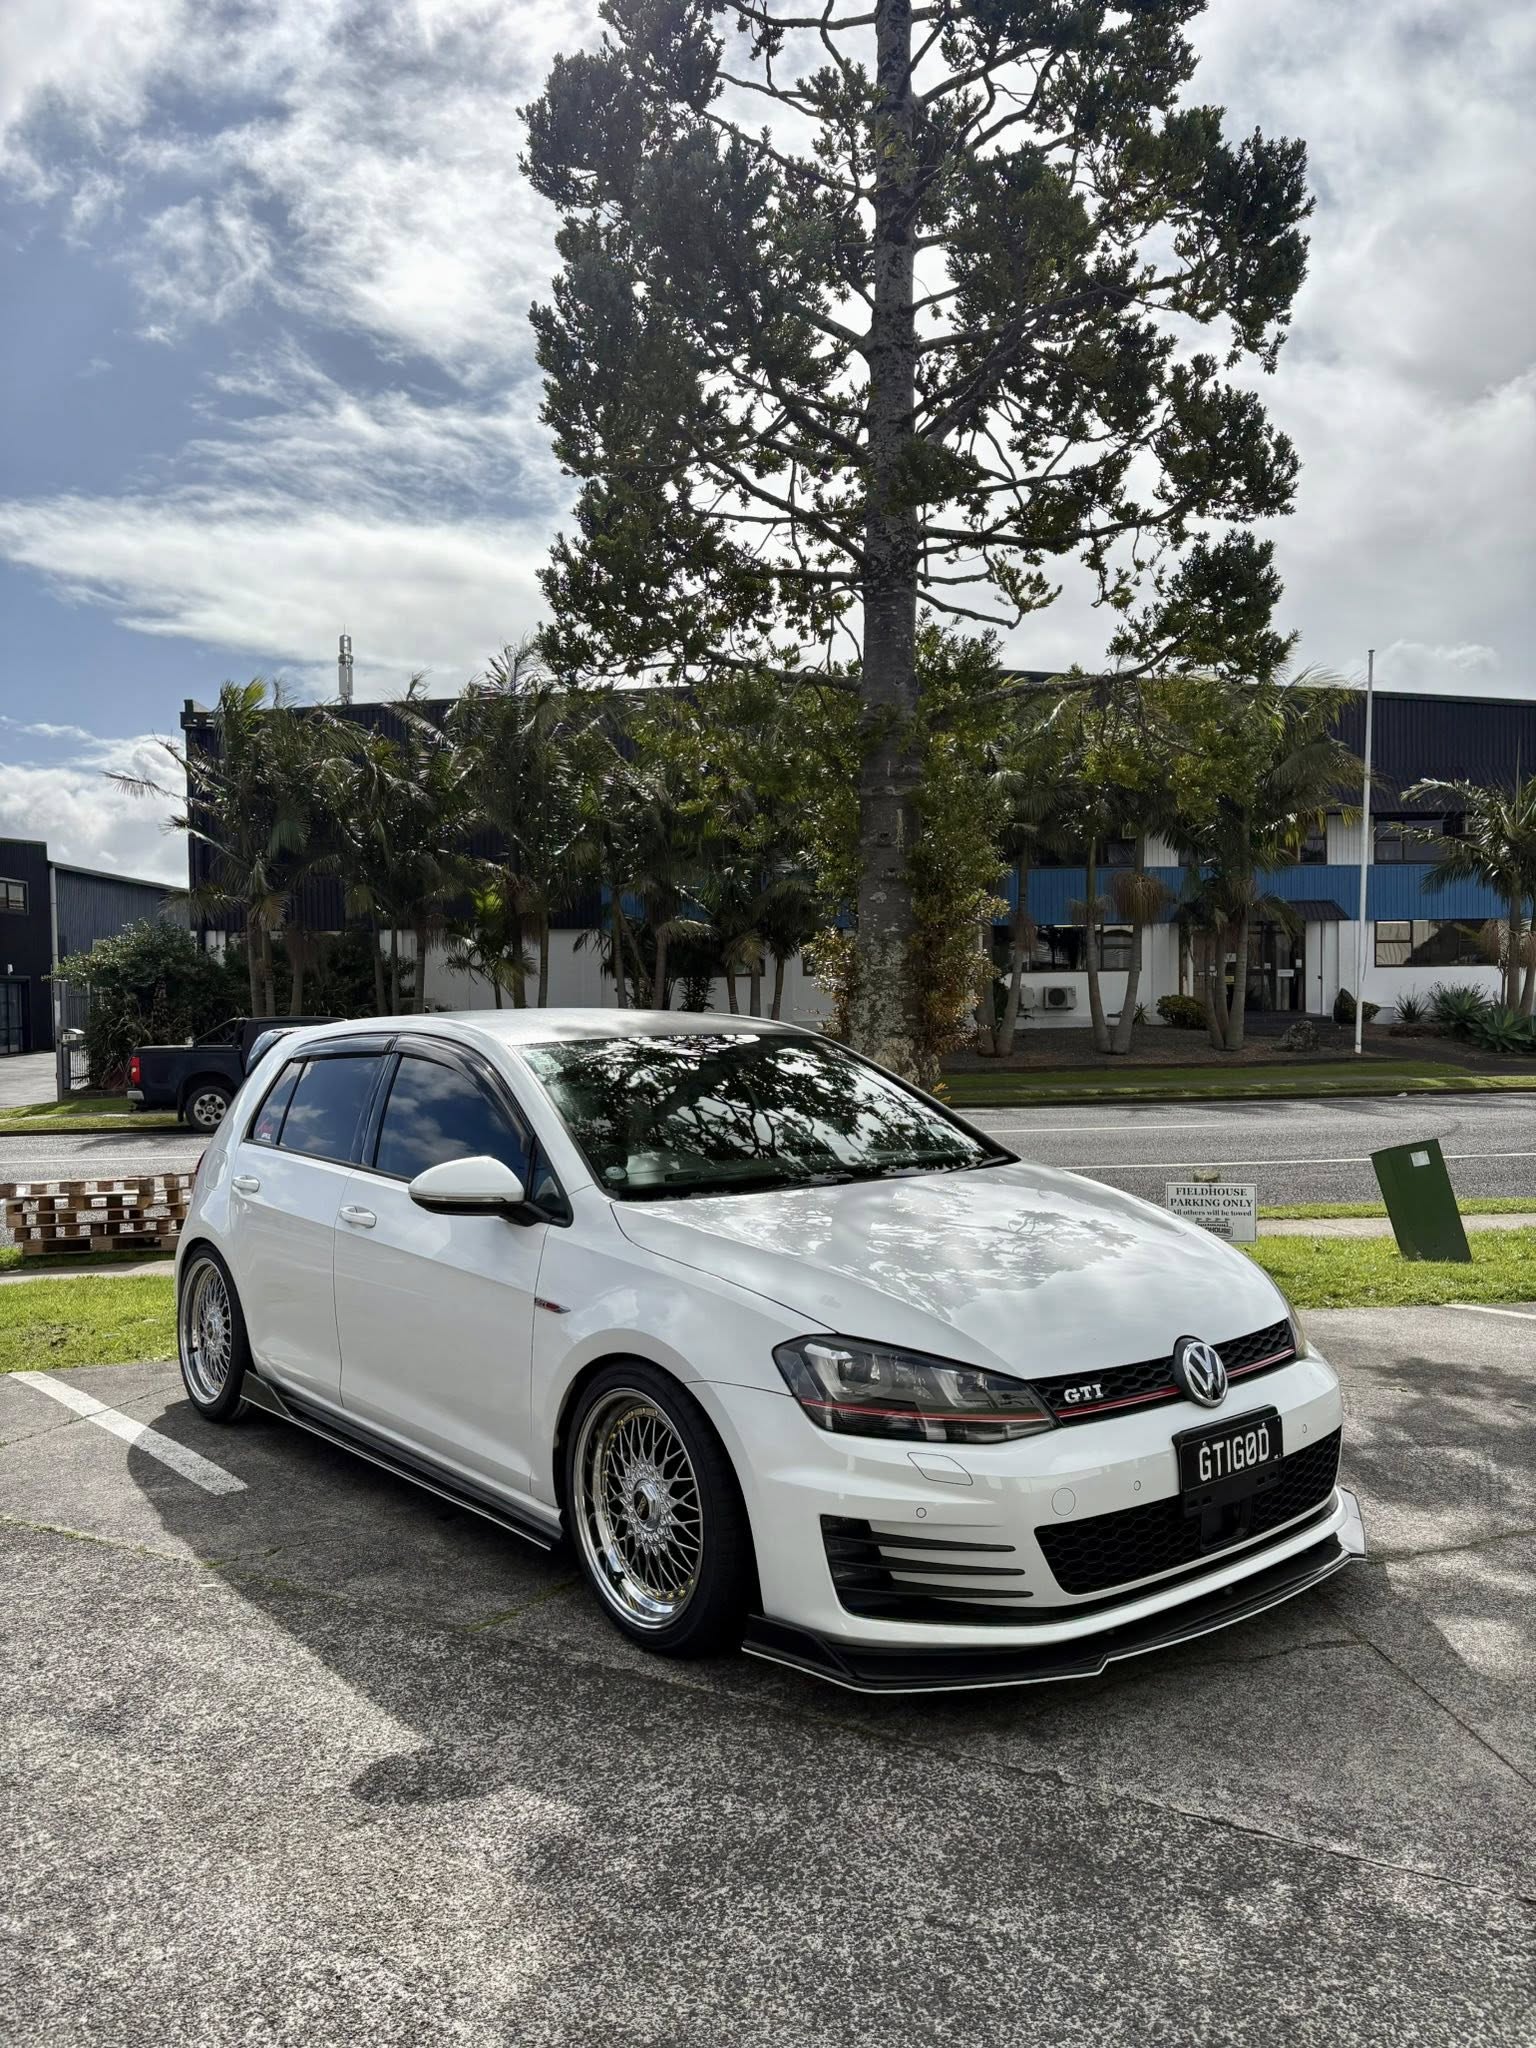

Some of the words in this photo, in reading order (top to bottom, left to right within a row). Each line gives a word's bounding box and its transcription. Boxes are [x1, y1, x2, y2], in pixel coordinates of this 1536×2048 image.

[1176, 1187, 1247, 1196] FIELDHOUSE
[1170, 1198, 1220, 1207] PARKING
[1222, 1199, 1253, 1207] ONLY
[1064, 1383, 1104, 1403] GTI
